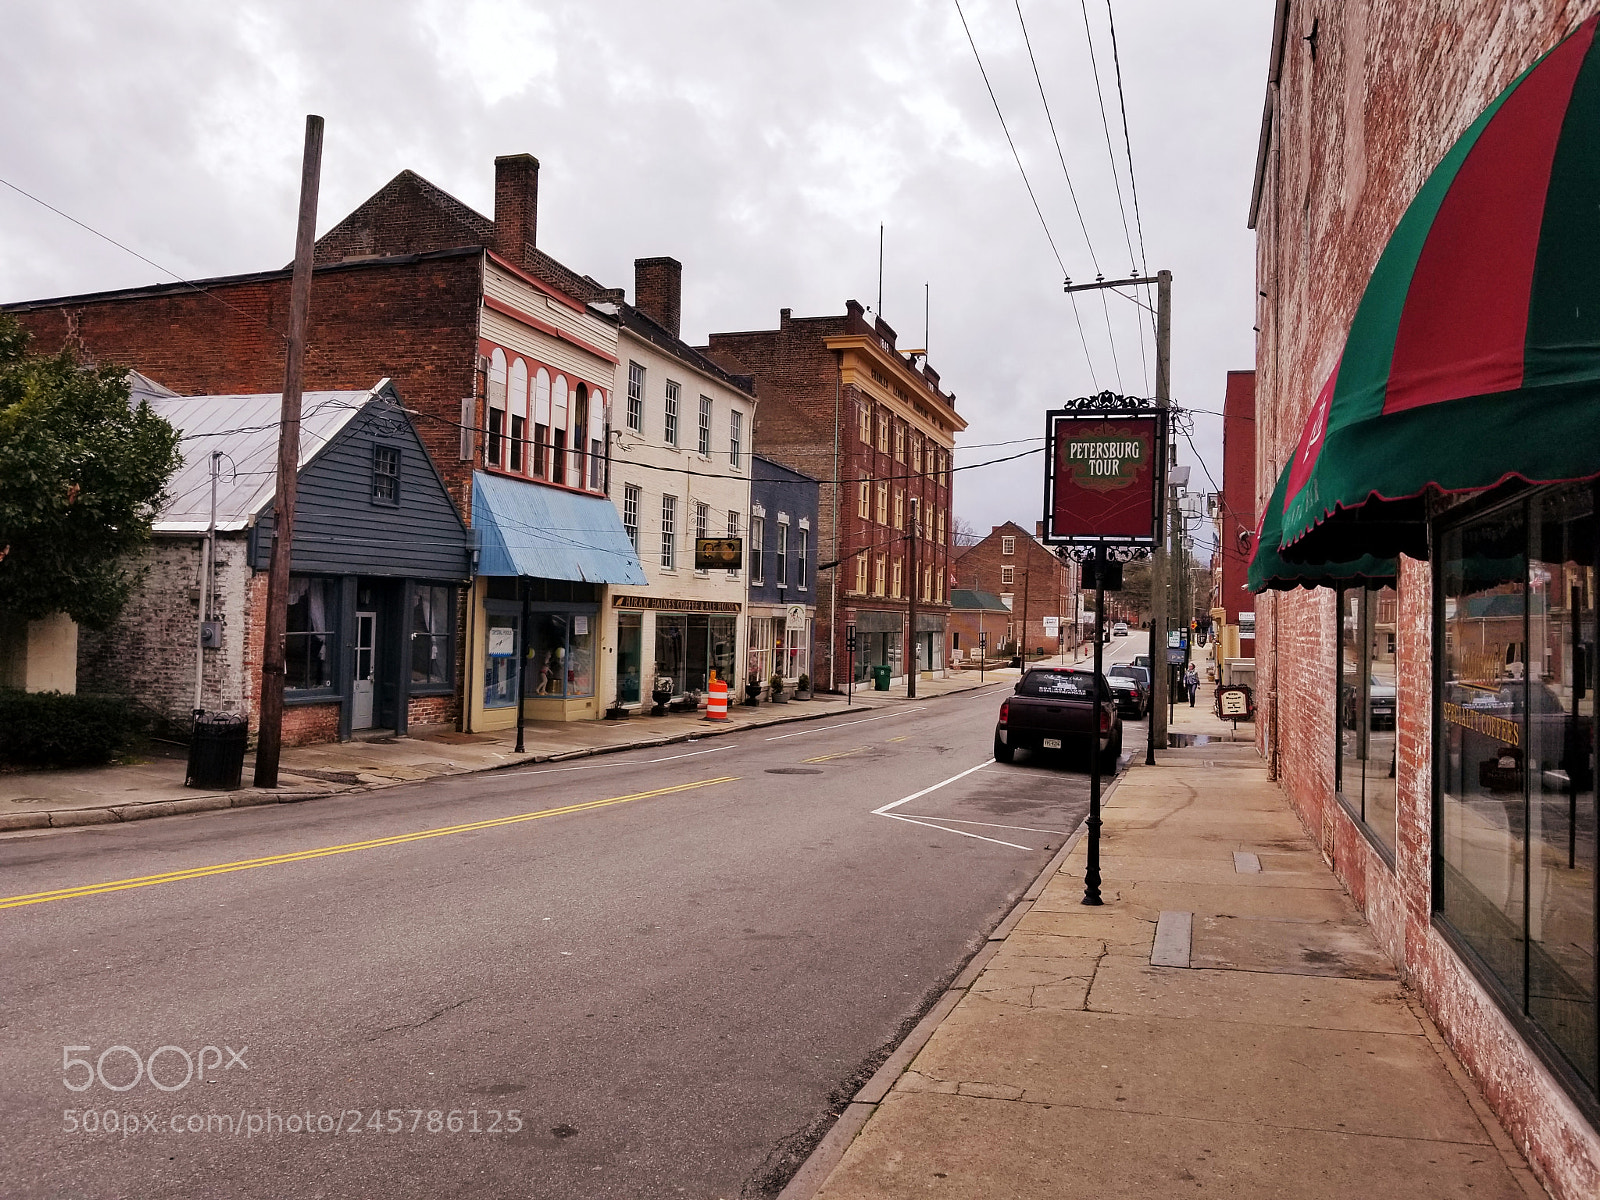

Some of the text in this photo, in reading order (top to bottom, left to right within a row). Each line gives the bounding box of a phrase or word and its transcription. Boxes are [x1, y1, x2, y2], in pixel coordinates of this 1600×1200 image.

[1070, 441, 1140, 459] PETERSBURG
[1088, 459, 1120, 476] TOUR
[625, 597, 649, 608] HIRAM
[651, 598, 677, 610] HAINES
[677, 600, 699, 610] COFFEE
[1443, 702, 1519, 746] SPECIALTY COFFEES
